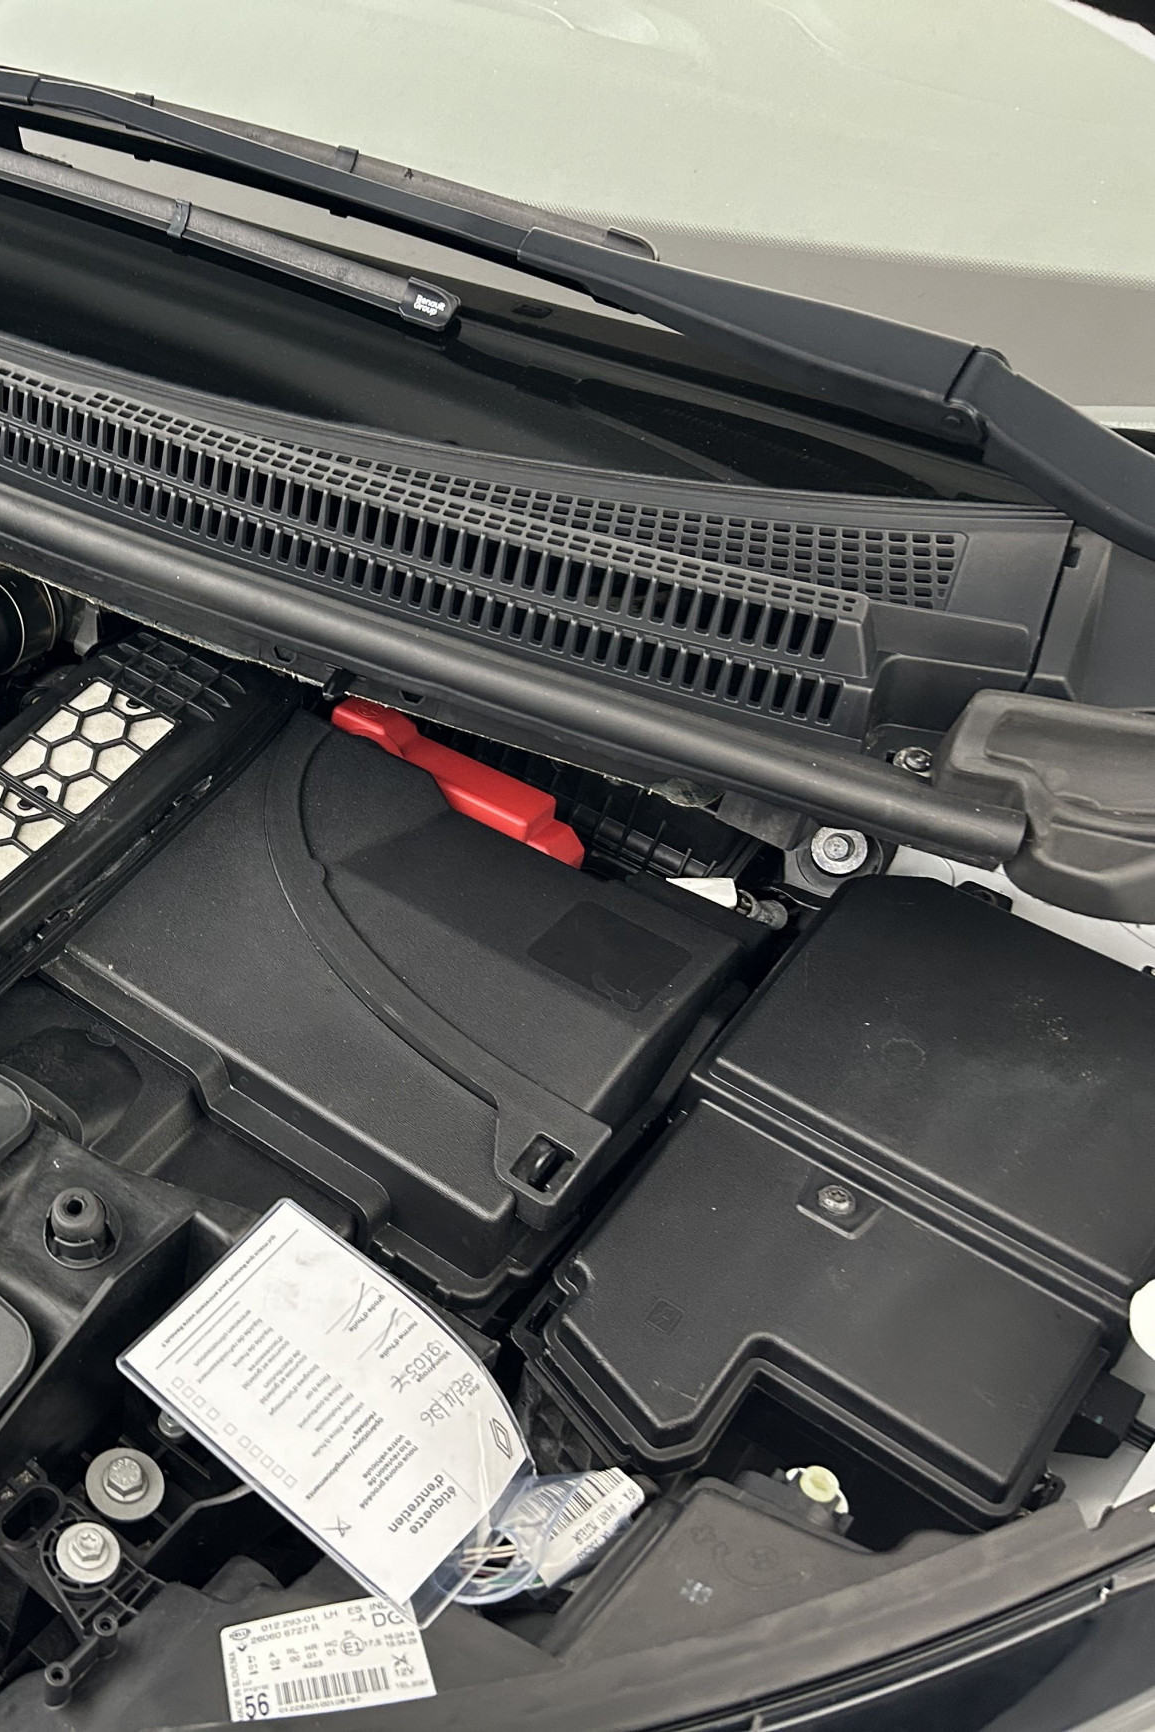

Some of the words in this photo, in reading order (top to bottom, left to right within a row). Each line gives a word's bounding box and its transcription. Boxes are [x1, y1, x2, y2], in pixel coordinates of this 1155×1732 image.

[414, 301, 438, 316] Group
[416, 294, 446, 312] Renault
[366, 1294, 386, 1313] grade
[348, 1311, 368, 1332] d'huile
[398, 1320, 418, 1340] norme
[379, 1338, 400, 1359] d'huile
[415, 1350, 451, 1383] kilométrage
[386, 1434, 405, 1452] votre
[398, 1444, 408, 1453] la
[401, 1445, 418, 1462] nous
[362, 1451, 388, 1479] véhicule
[375, 1450, 400, 1477] révision
[383, 1460, 404, 1482] avons
[367, 1476, 377, 1486] de
[358, 1478, 386, 1509] procédé
[388, 1474, 444, 1532] d'entretien
[409, 1485, 457, 1534] étiquette
[571, 1520, 599, 1545] MOTEUR
[323, 1609, 338, 1620] LH
[244, 1692, 270, 1720] 56
